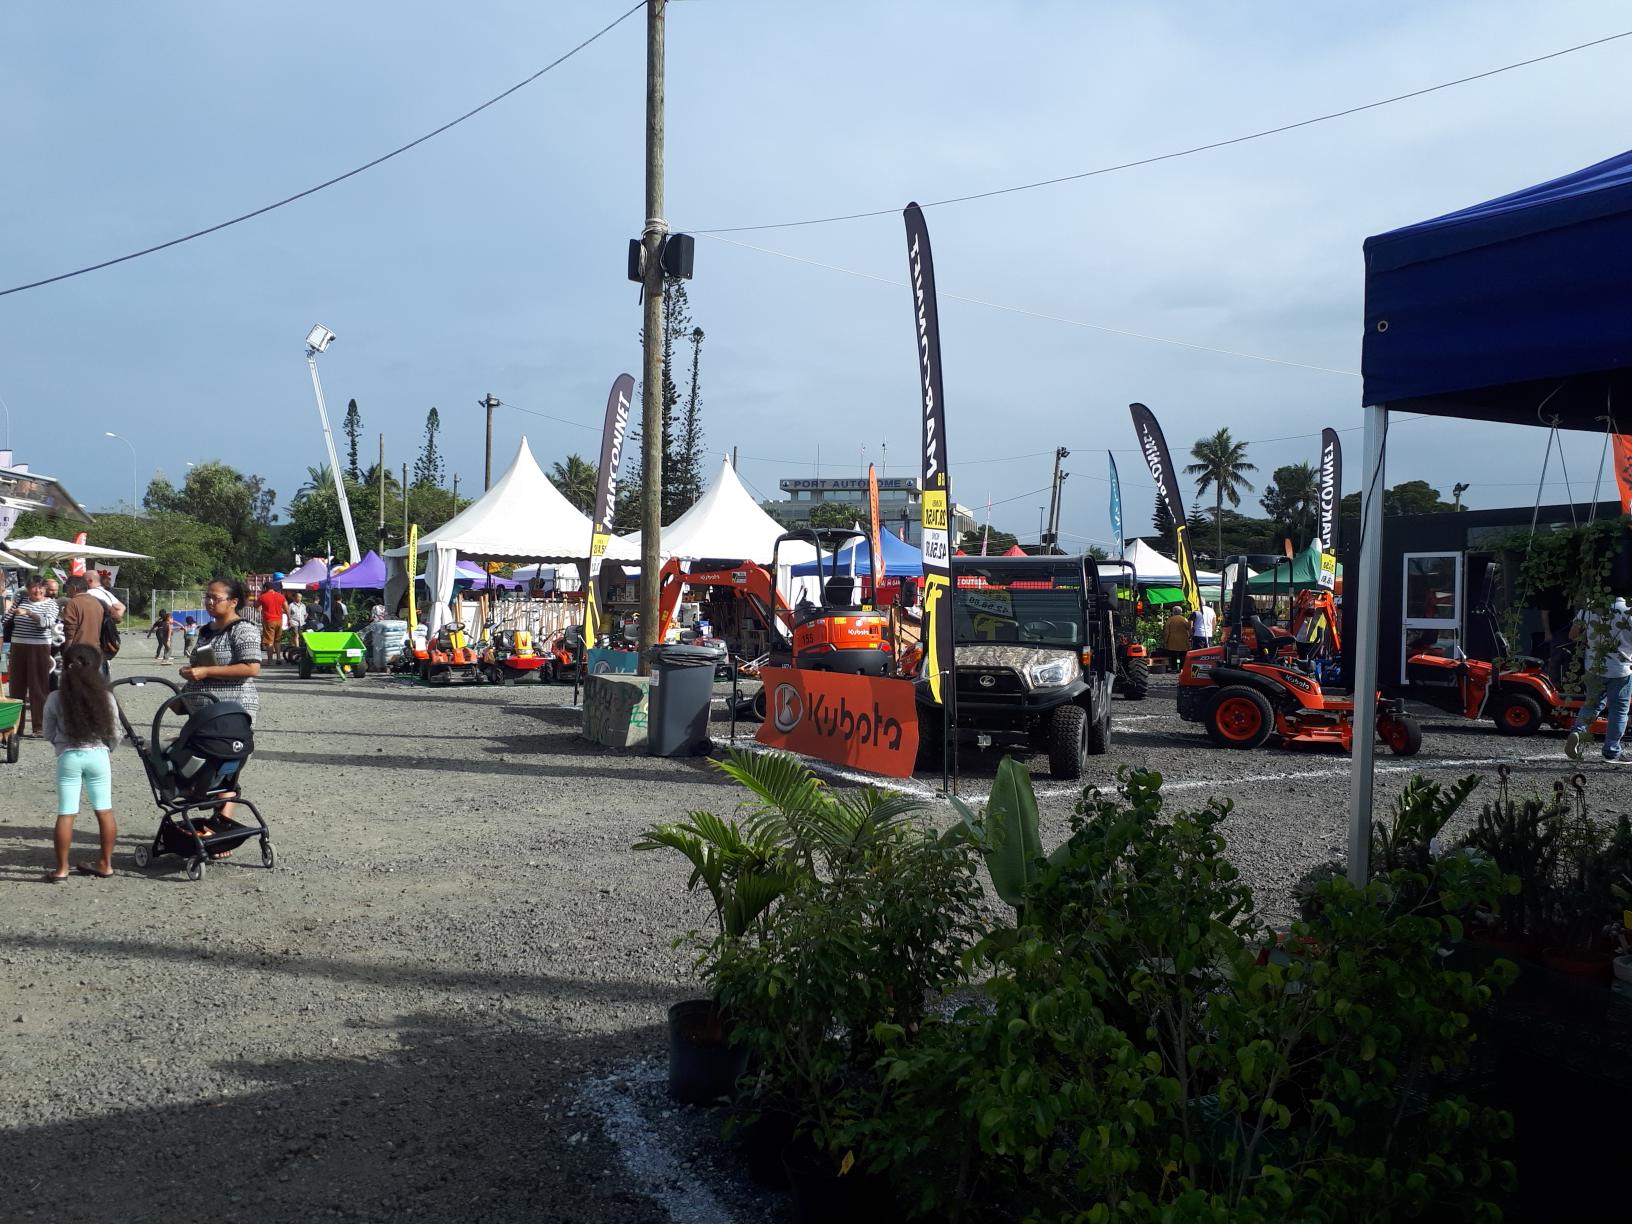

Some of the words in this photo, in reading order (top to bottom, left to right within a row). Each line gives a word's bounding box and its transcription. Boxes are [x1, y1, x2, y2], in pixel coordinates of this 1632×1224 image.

[603, 390, 631, 531] MARCONNET
[793, 480, 827, 488] PORT
[832, 480, 901, 488] AUTOOME
[847, 628, 870, 636] Kubota
[1285, 674, 1310, 690] Kubota
[808, 692, 903, 751] Kubota
